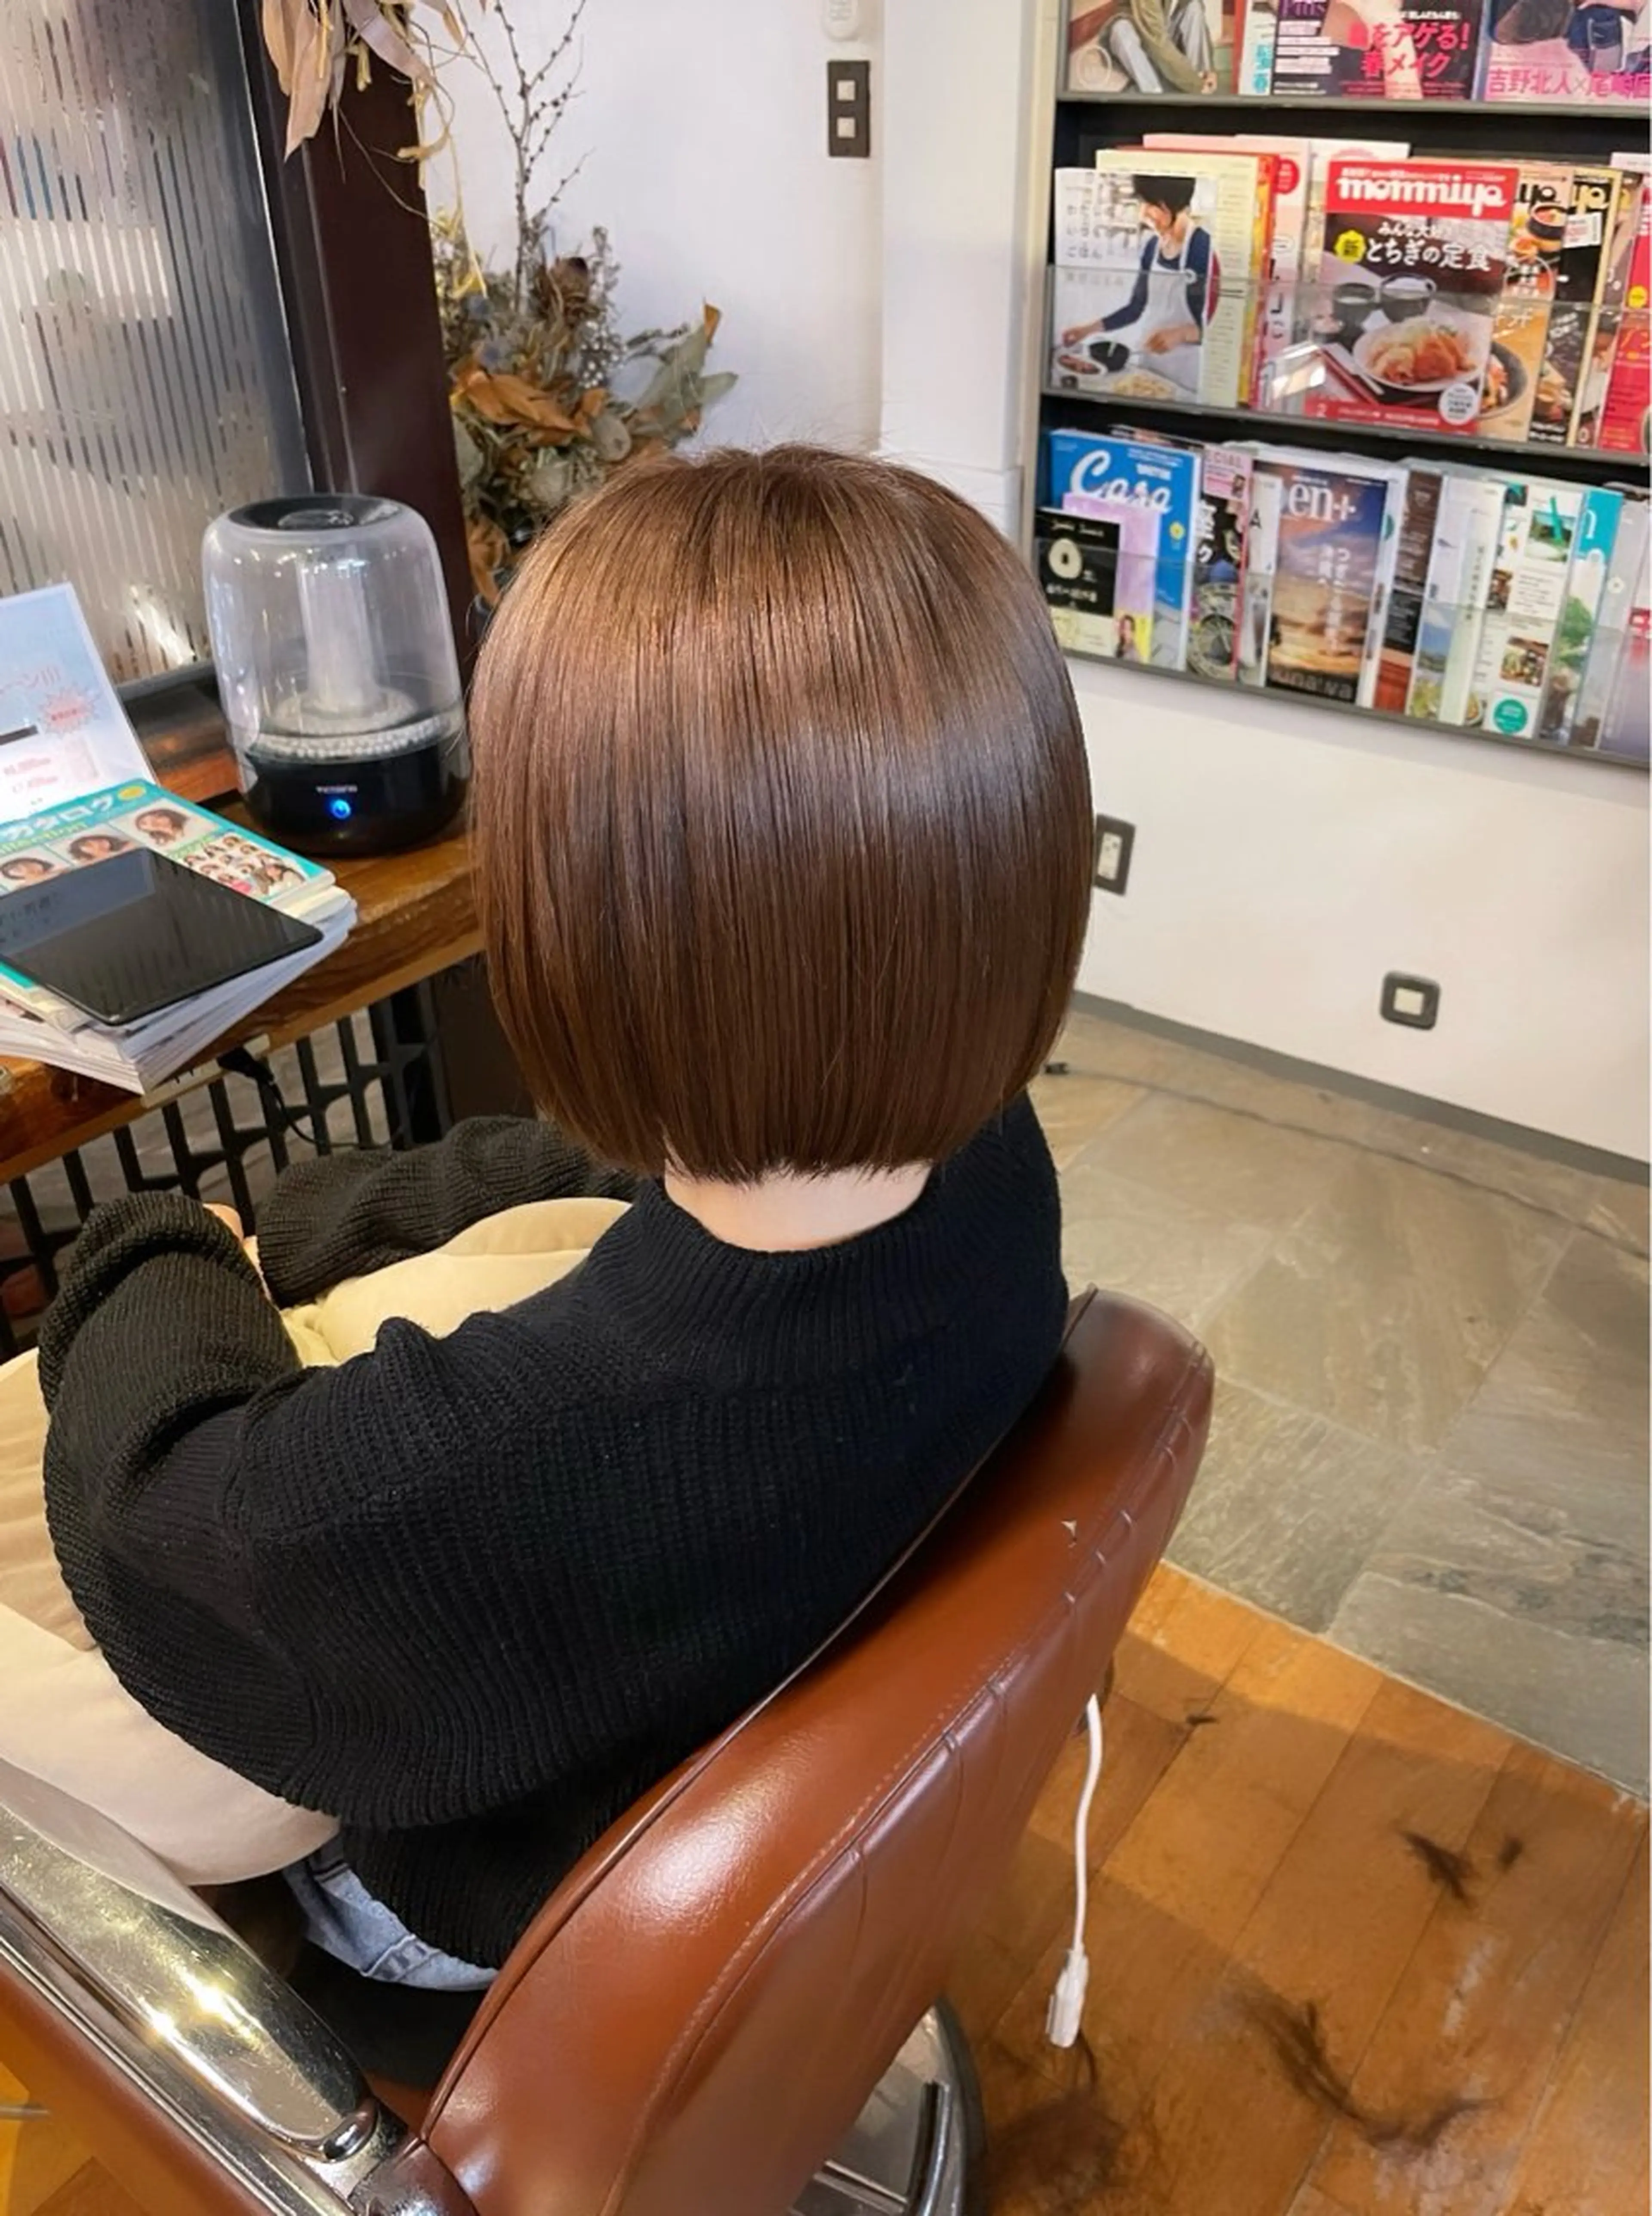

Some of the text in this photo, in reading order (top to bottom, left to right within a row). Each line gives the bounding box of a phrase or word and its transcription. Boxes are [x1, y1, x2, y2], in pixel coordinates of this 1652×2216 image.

[1336, 174, 1507, 216] monmiya
[1366, 238, 1491, 272] とちぎの定食
[1070, 450, 1173, 515] Casa
